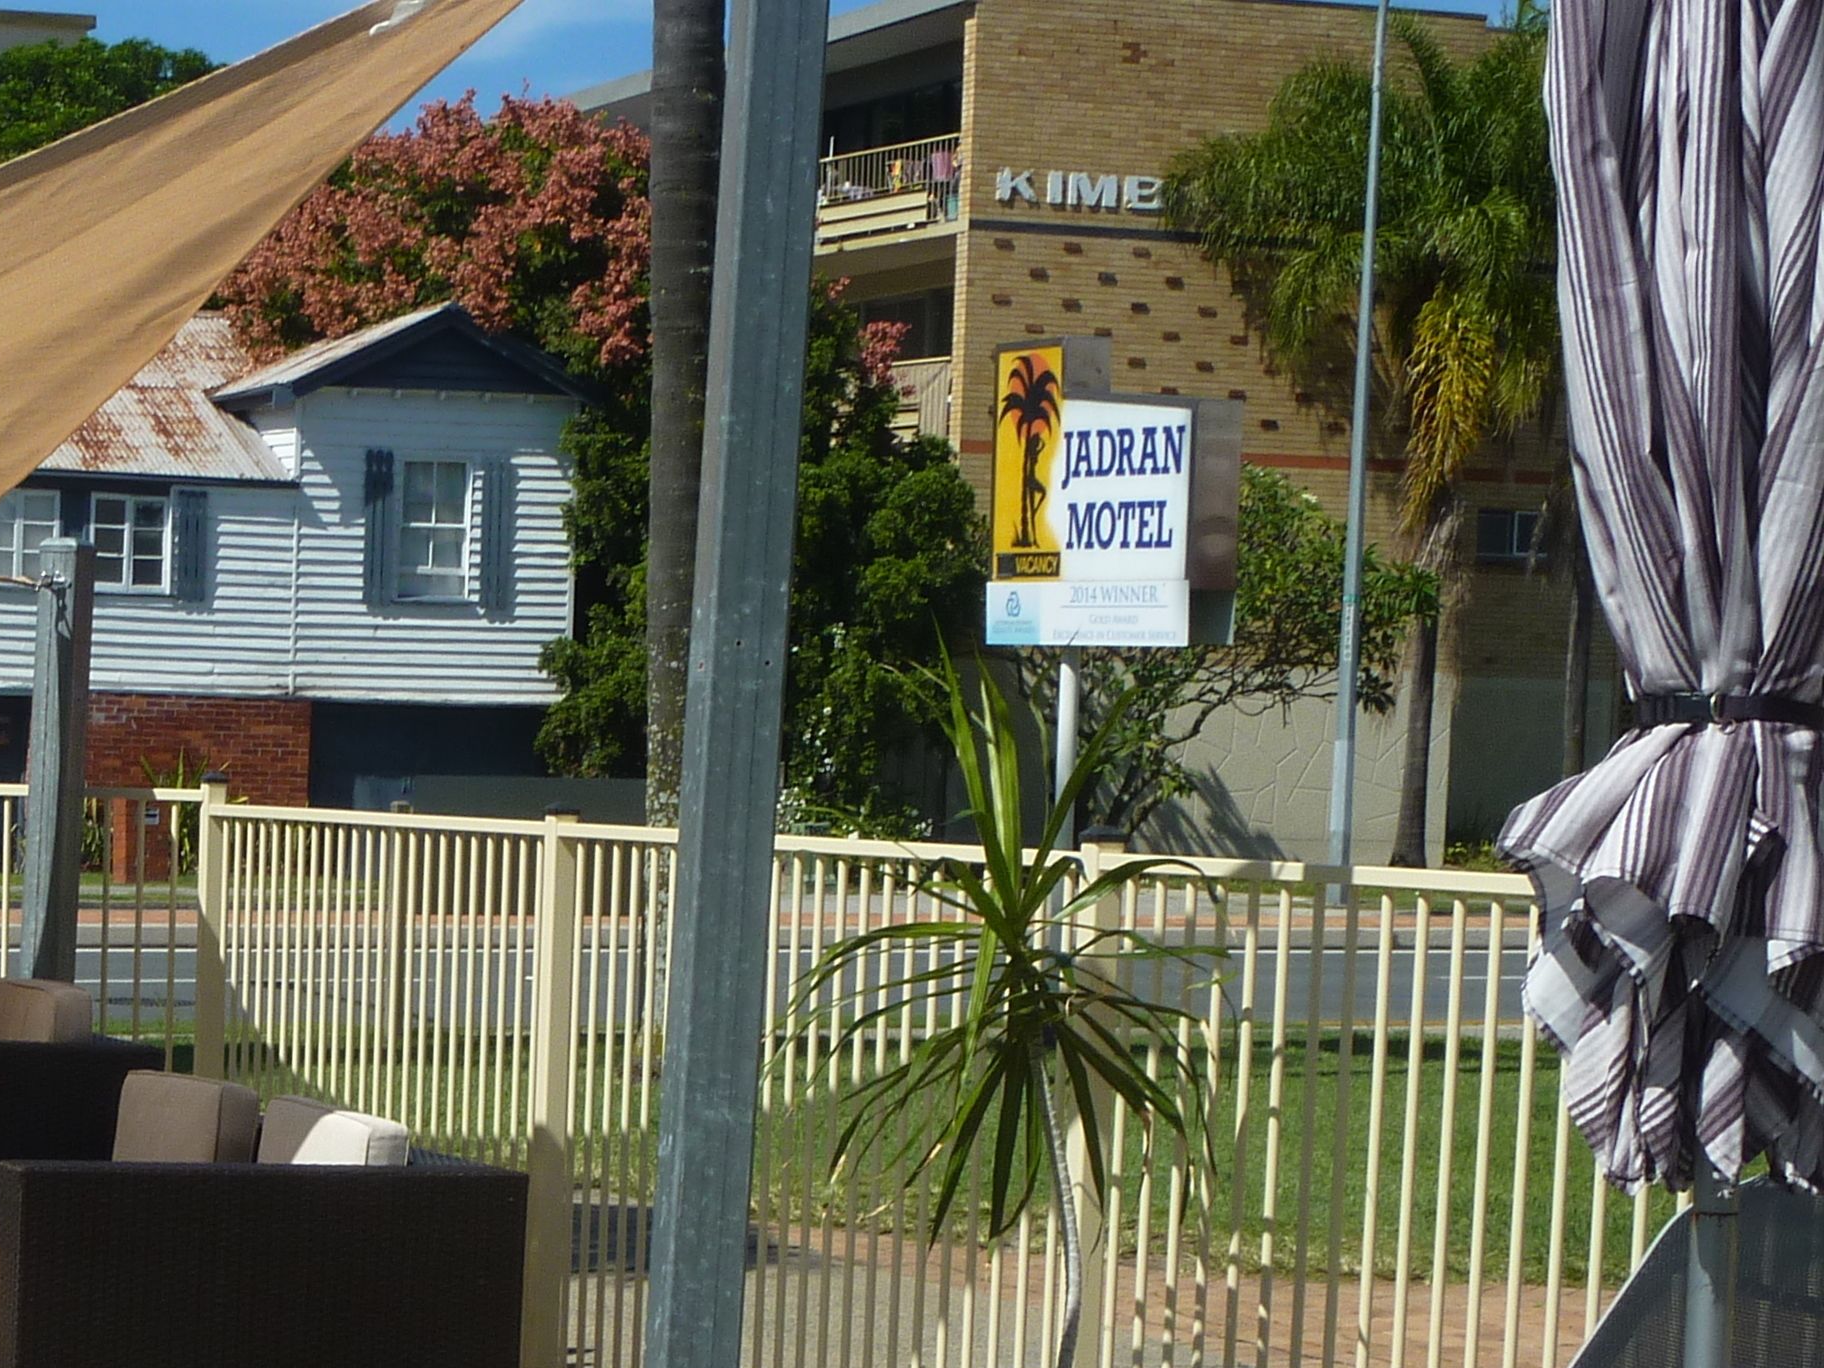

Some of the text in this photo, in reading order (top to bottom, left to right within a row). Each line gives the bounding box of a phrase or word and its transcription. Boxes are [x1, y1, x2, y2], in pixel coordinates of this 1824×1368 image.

[1061, 424, 1185, 490] JADRAN
[1065, 500, 1173, 550] MOTEL
[1015, 555, 1058, 574] VACANCY
[1070, 585, 1158, 603] 2014 WINNER
